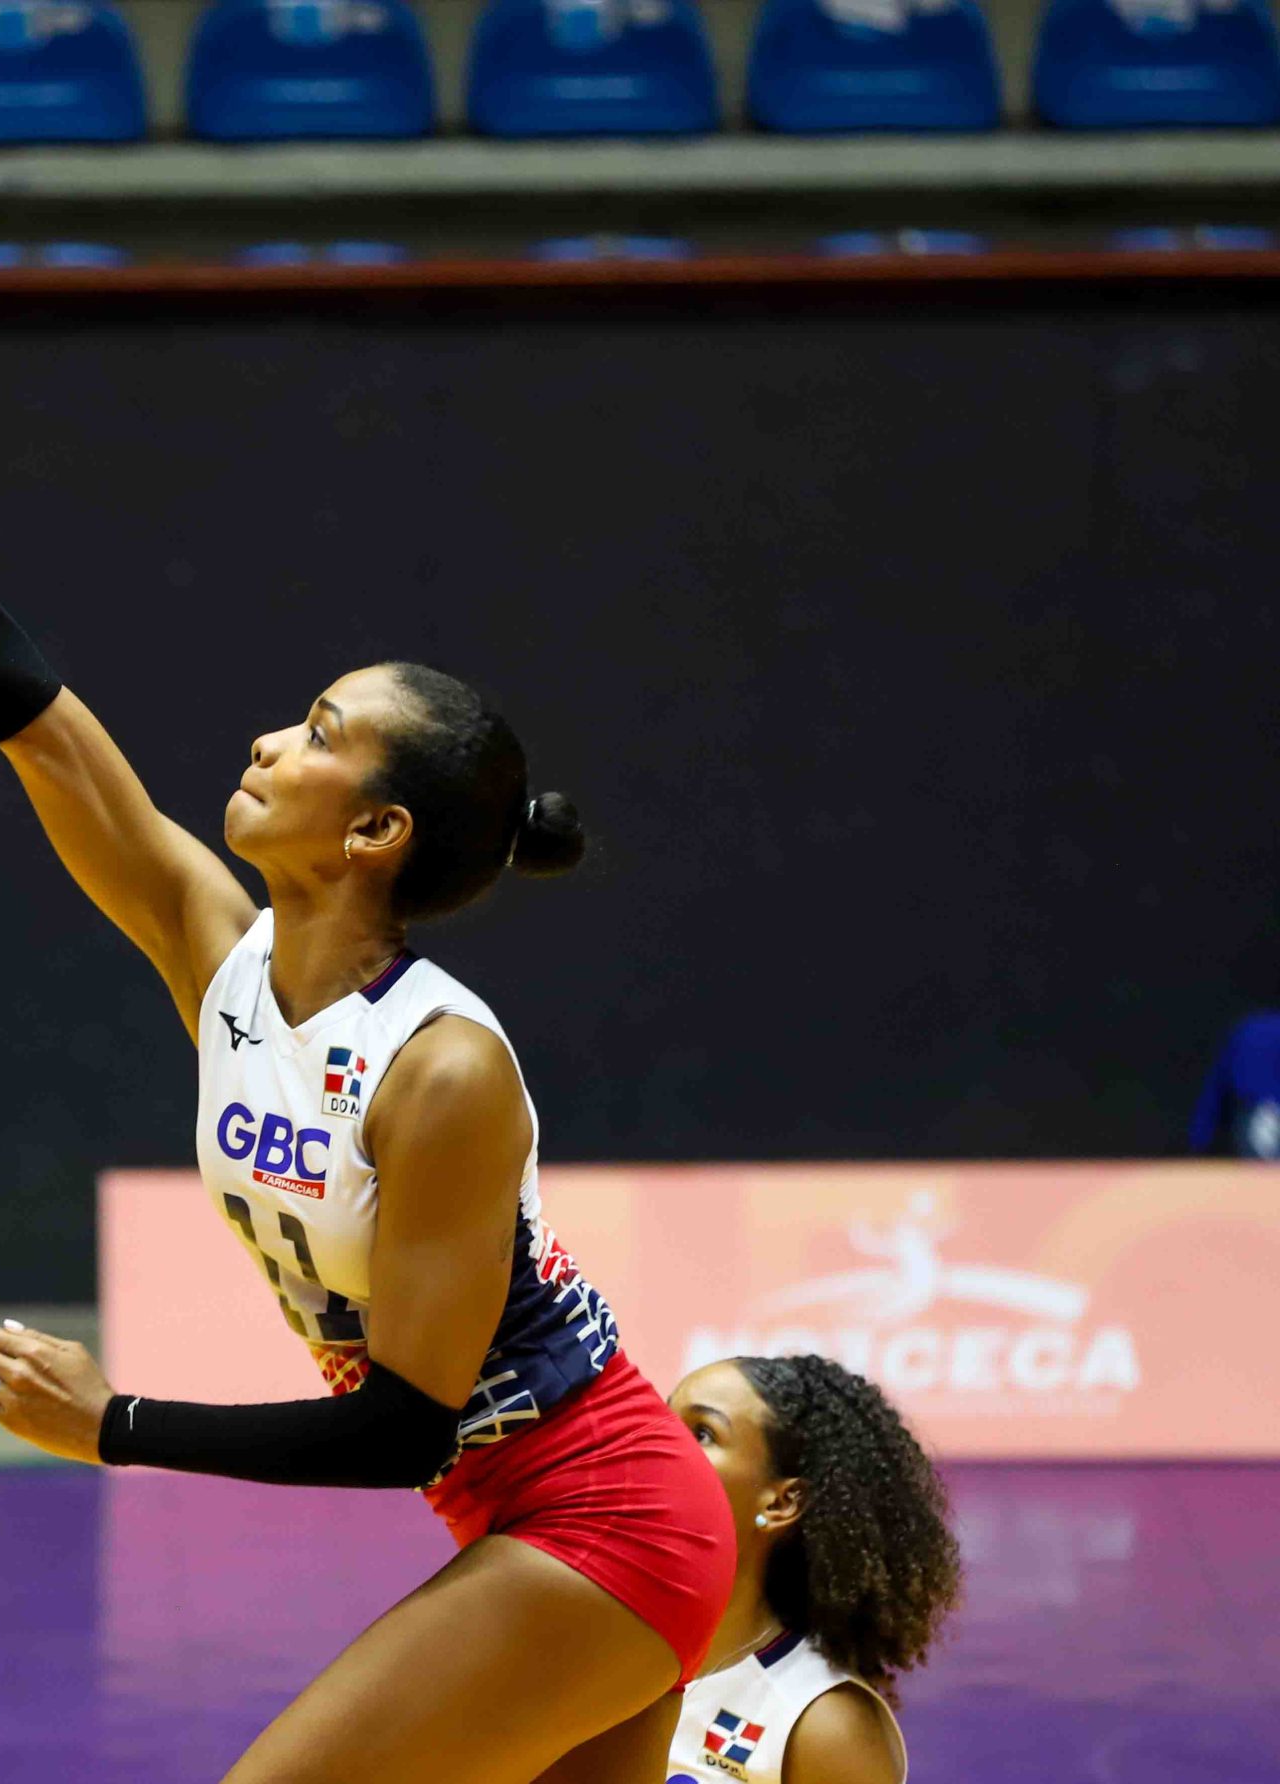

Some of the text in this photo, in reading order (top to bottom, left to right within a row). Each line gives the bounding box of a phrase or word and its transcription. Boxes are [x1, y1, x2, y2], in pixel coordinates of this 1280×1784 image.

[330, 1097, 360, 1116] DOM
[216, 1102, 332, 1182] GBC
[260, 1173, 320, 1198] FARMACIAS
[222, 1192, 366, 1342] 11
